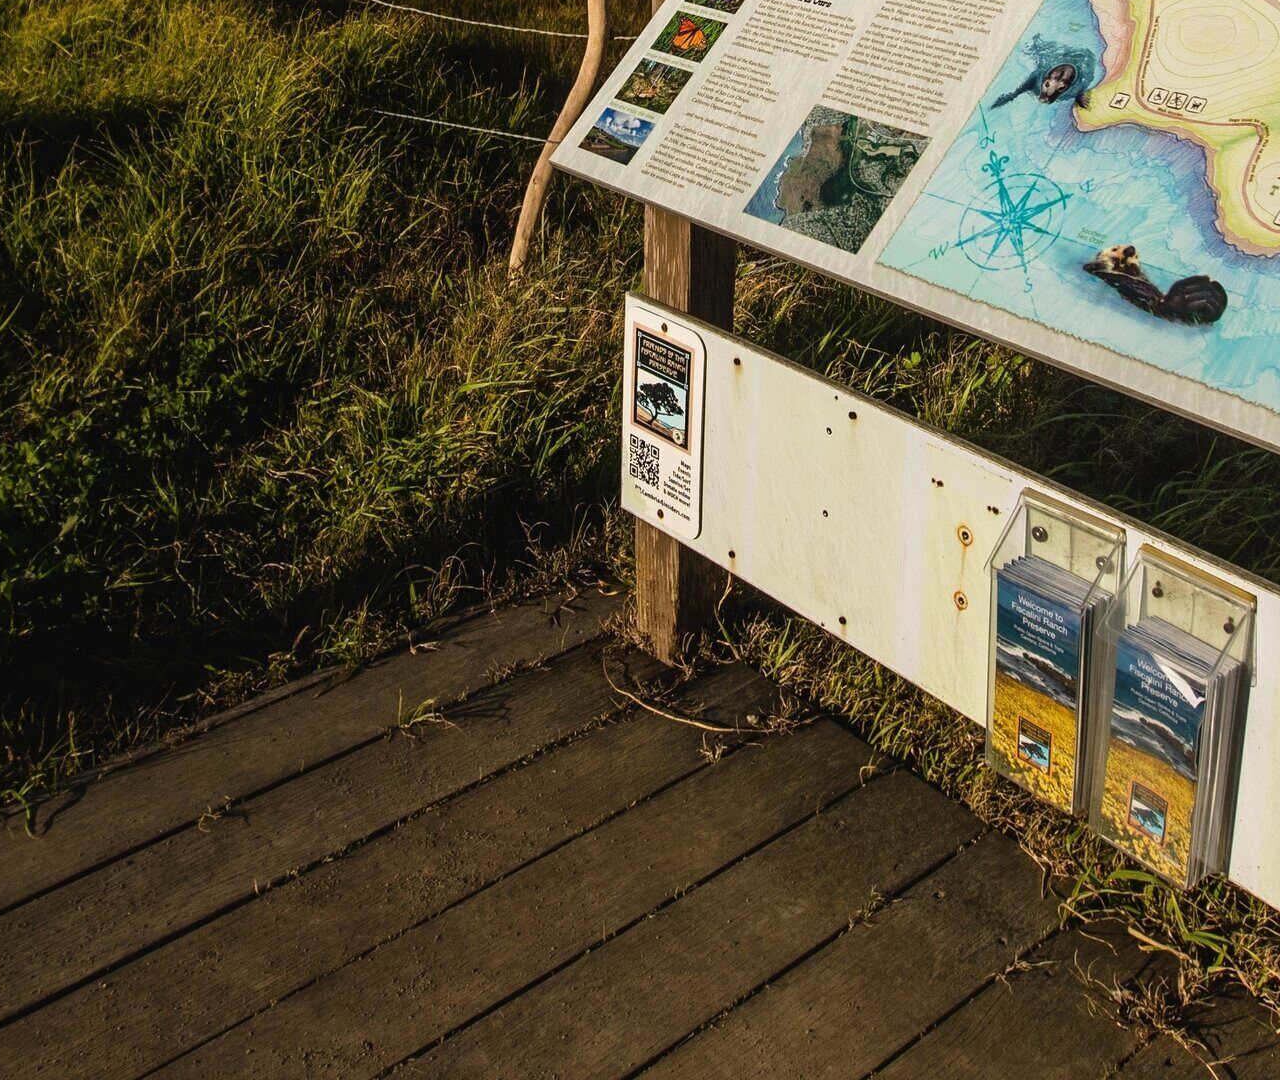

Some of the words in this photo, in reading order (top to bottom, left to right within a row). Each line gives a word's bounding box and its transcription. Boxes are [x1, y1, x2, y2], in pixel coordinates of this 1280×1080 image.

[1011, 601, 1041, 622] Fiscalini
[1043, 616, 1068, 636] Ranch
[1018, 594, 1053, 618] Welcome
[1055, 612, 1063, 622] to
[1023, 617, 1056, 640] Preserve
[1137, 658, 1169, 680] Welco
[1129, 664, 1162, 688] Fiscalini
[1165, 684, 1189, 704] Ranc
[1141, 681, 1178, 707] Preserve
